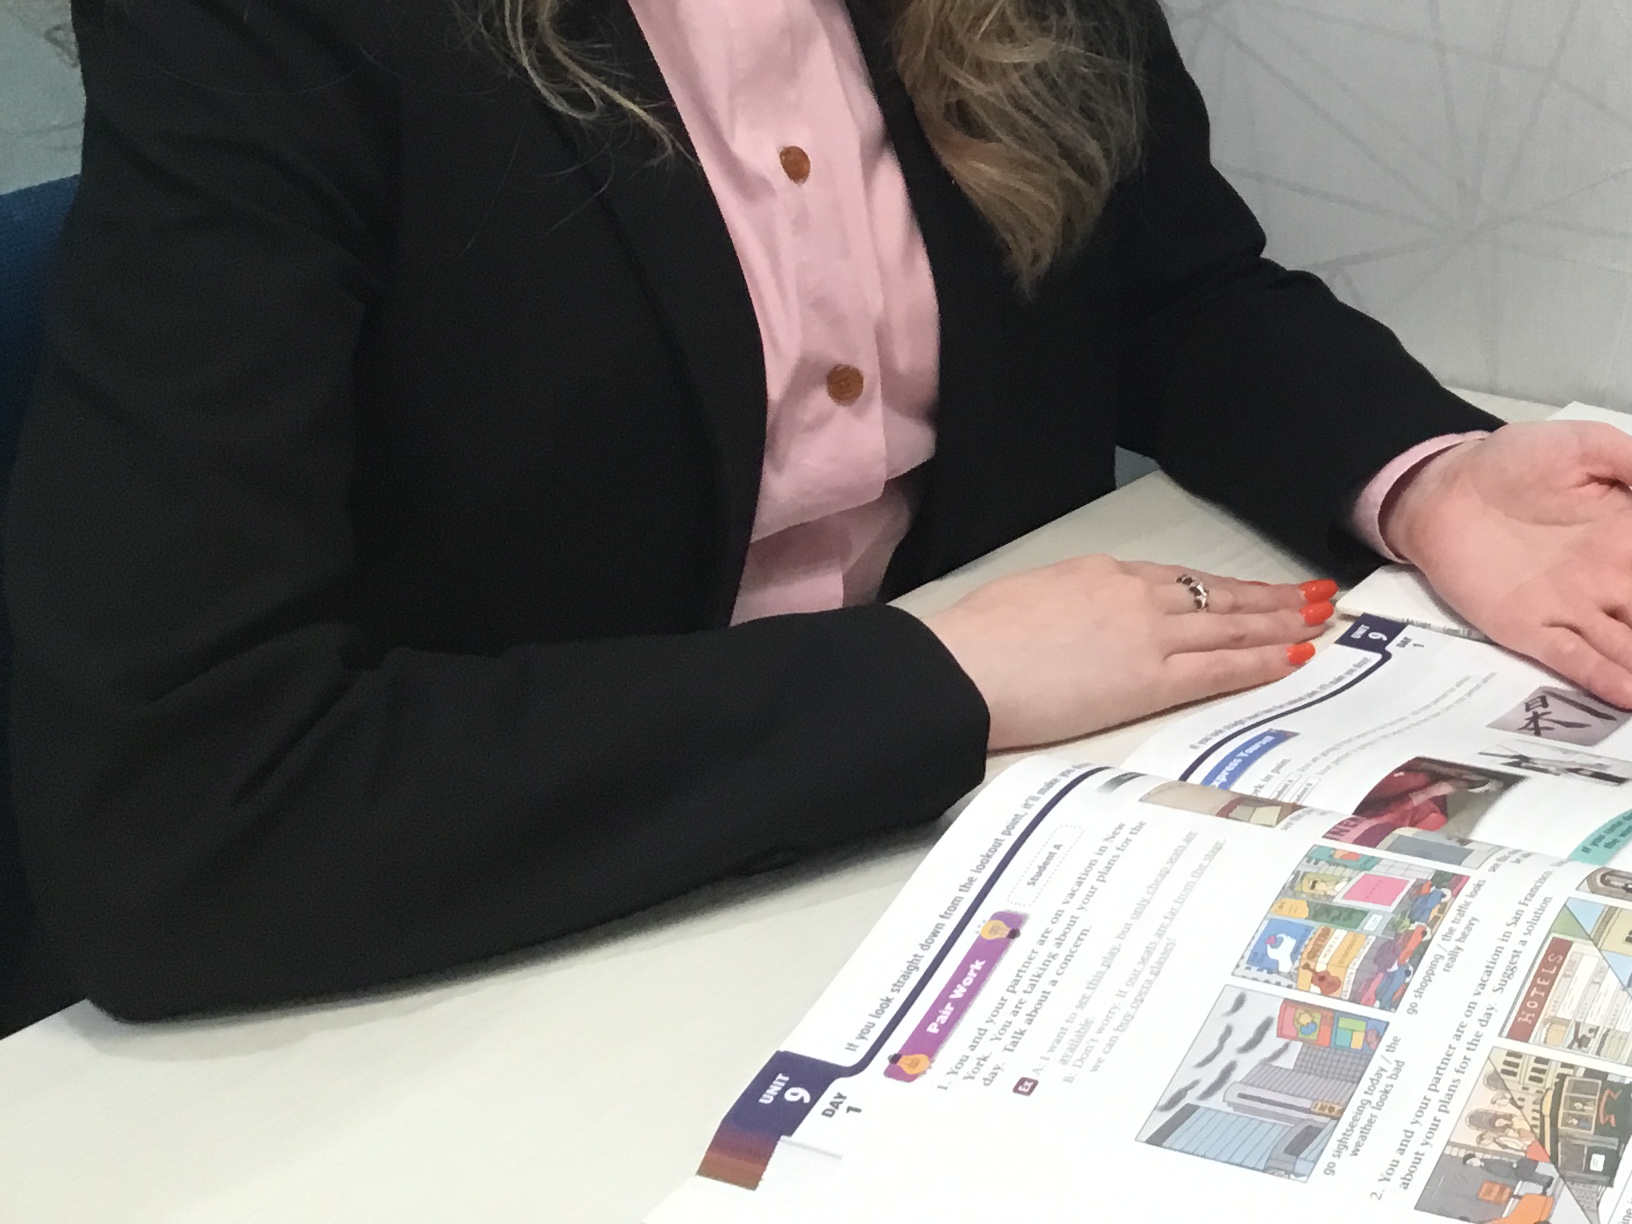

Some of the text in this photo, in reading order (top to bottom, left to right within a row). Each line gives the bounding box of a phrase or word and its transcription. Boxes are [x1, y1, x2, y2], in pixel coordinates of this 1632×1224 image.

[1368, 631, 1388, 642] 9
[1026, 849, 1058, 887] Student
[855, 1021, 876, 1041] you
[868, 995, 894, 1020] look
[891, 953, 925, 994] straight
[919, 922, 946, 952] down
[939, 895, 965, 920] from
[958, 876, 978, 894] the
[970, 837, 1005, 874] lookout
[946, 1054, 970, 1076] You
[967, 1027, 988, 1052] and
[985, 995, 1008, 1025] your
[1006, 948, 1040, 994] partner
[1036, 926, 1053, 947] are
[1050, 908, 1065, 925] on
[1062, 857, 1099, 906] vacation
[1094, 844, 1109, 857] in
[1103, 821, 1126, 843] New
[962, 820, 1147, 1081] York. You are talking about your plans for the
[1047, 1026, 1069, 1054] want
[1065, 1011, 1078, 1024] to
[1074, 992, 1092, 1010] see
[1115, 922, 1134, 941] but
[1130, 895, 1151, 921] only
[1072, 1037, 1100, 1069] Don't
[1172, 879, 1195, 905] from
[1406, 1002, 1419, 1015] go
[1414, 953, 1445, 1000] shopping
[1441, 926, 1457, 942] the
[1465, 879, 1487, 899] looks
[1443, 916, 1480, 973] really heavy
[926, 958, 987, 1034] Pair Work
[982, 925, 1093, 1087] day. Talk about a concern.
[1090, 1056, 1106, 1073] we
[1102, 1034, 1120, 1055] can
[1113, 1011, 1135, 1034] buy
[1130, 978, 1154, 1010] opera
[1518, 951, 1563, 1025] HOTELS
[758, 1073, 790, 1105] UNIT
[1018, 1080, 1034, 1093] Ex
[1370, 1188, 1386, 1201] 2.
[1378, 1157, 1401, 1184] You
[1395, 1129, 1416, 1156] and
[1410, 1095, 1432, 1126] your
[1427, 1043, 1457, 1094] partner
[1453, 1022, 1468, 1042] are
[1463, 999, 1479, 1019] on
[1473, 944, 1505, 998] vacation
[1498, 929, 1513, 945] in
[1506, 908, 1525, 929] San
[1399, 895, 1554, 1190] about your plans for the day. Suggest a solution.
[783, 1086, 811, 1104] 9
[821, 1092, 847, 1118] DAY
[846, 1105, 863, 1114] 1
[1323, 1161, 1336, 1176] go
[1332, 1097, 1372, 1159] sightseeing
[1364, 1066, 1388, 1096] today
[1386, 1035, 1402, 1054] the
[1349, 1060, 1406, 1157] weather looks bad
